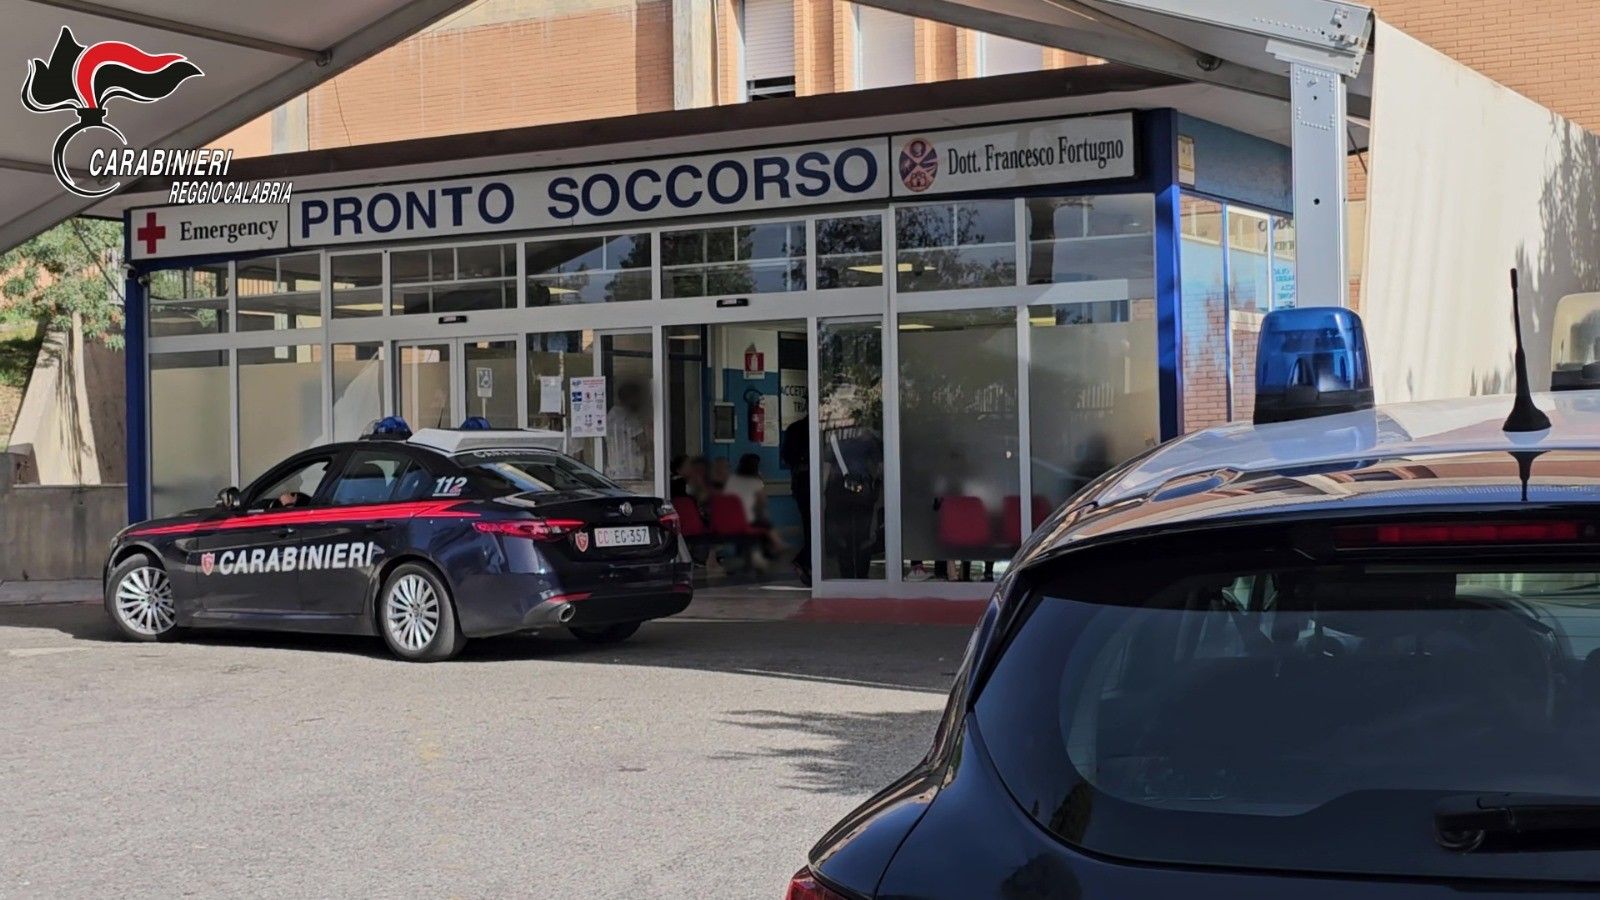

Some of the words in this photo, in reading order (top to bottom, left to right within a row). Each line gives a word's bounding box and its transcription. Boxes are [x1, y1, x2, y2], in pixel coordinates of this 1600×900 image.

[948, 147, 981, 175] Dott.
[985, 143, 1054, 172] Francesco
[1058, 136, 1124, 170] Fortugno
[300, 182, 515, 239] PRONTO
[547, 147, 878, 220] SOCCORSO
[180, 220, 279, 244] Emergency
[434, 476, 468, 495] 112
[597, 530, 610, 544] CC
[218, 541, 374, 575] CARABINIERI
